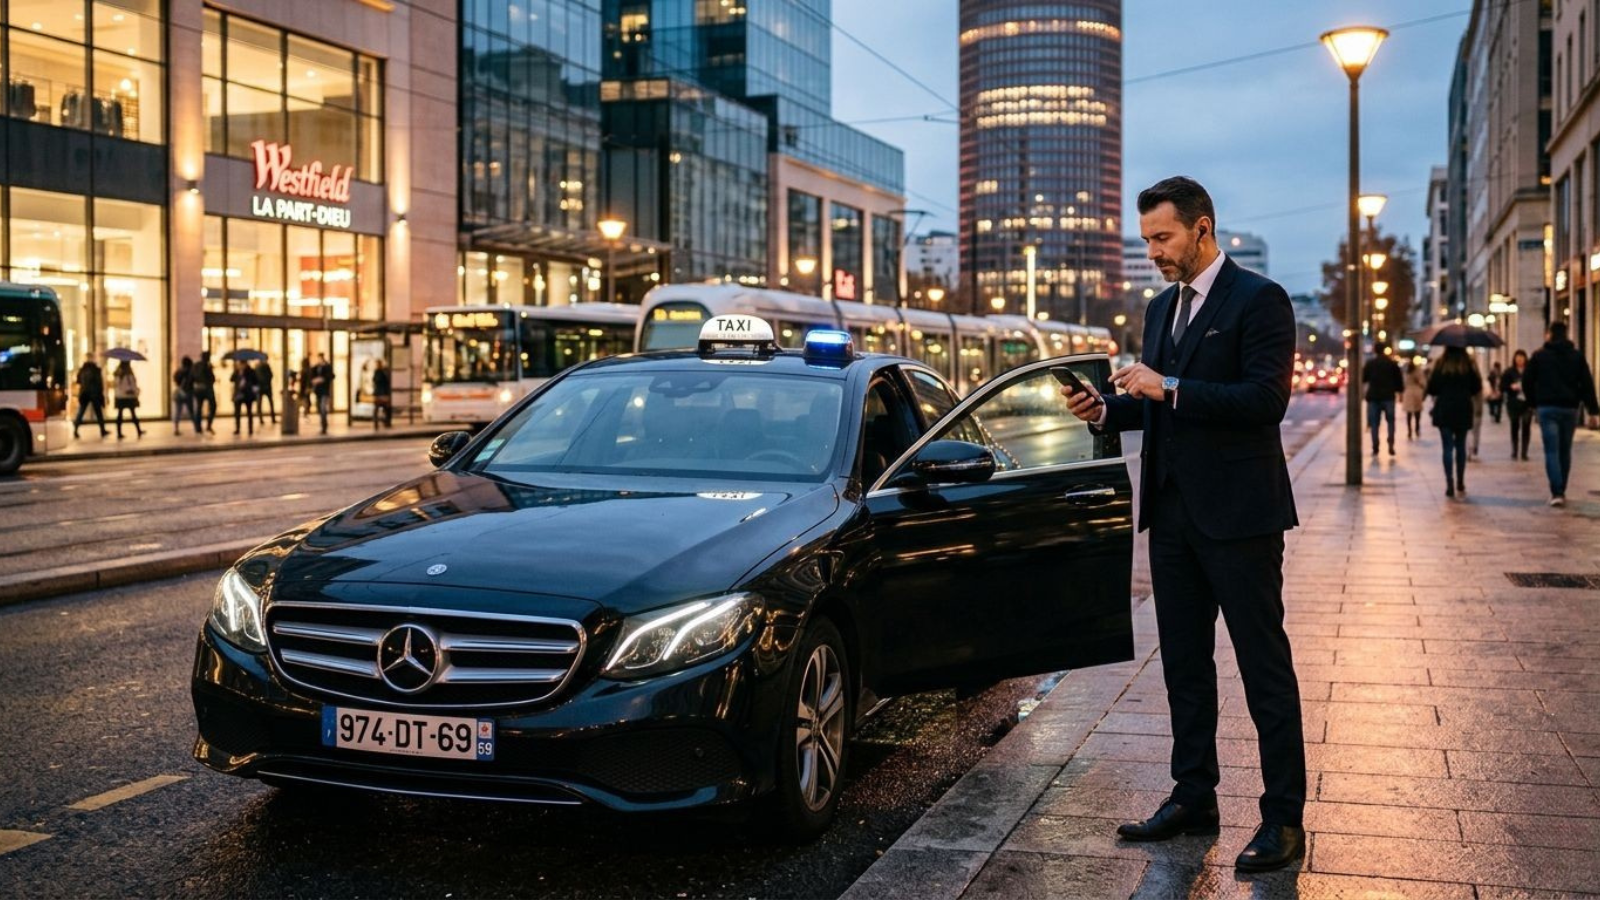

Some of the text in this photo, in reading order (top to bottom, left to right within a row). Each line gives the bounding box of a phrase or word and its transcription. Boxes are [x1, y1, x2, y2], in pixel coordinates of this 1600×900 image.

[251, 139, 354, 202] Westfield
[253, 195, 275, 217] LA
[716, 319, 751, 331] TAXI
[340, 714, 472, 753] 974-DT-69
